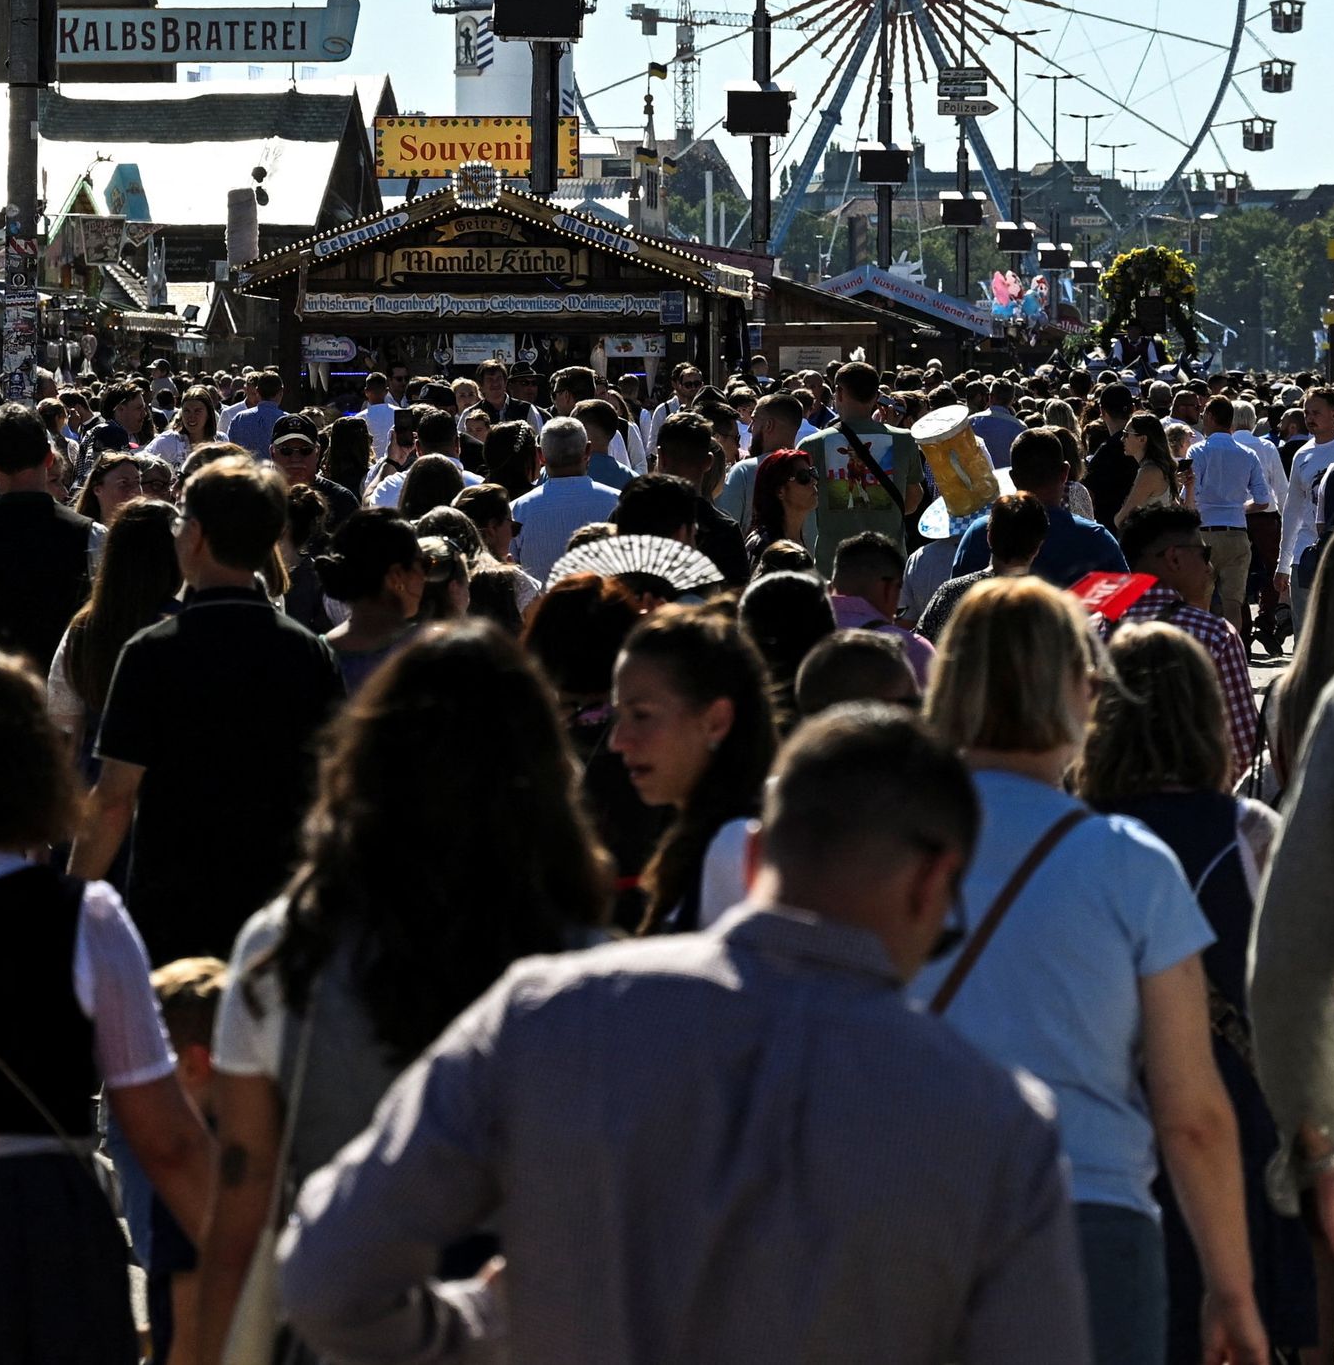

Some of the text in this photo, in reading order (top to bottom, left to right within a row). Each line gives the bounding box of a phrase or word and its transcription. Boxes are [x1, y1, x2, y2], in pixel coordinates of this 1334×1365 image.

[943, 102, 981, 112] Polizei
[318, 215, 402, 256] Gebrannte
[559, 214, 631, 254] Mandeln
[375, 294, 435, 313] Magenbrot
[439, 294, 486, 317] Popcorn
[903, 289, 926, 303] nach
